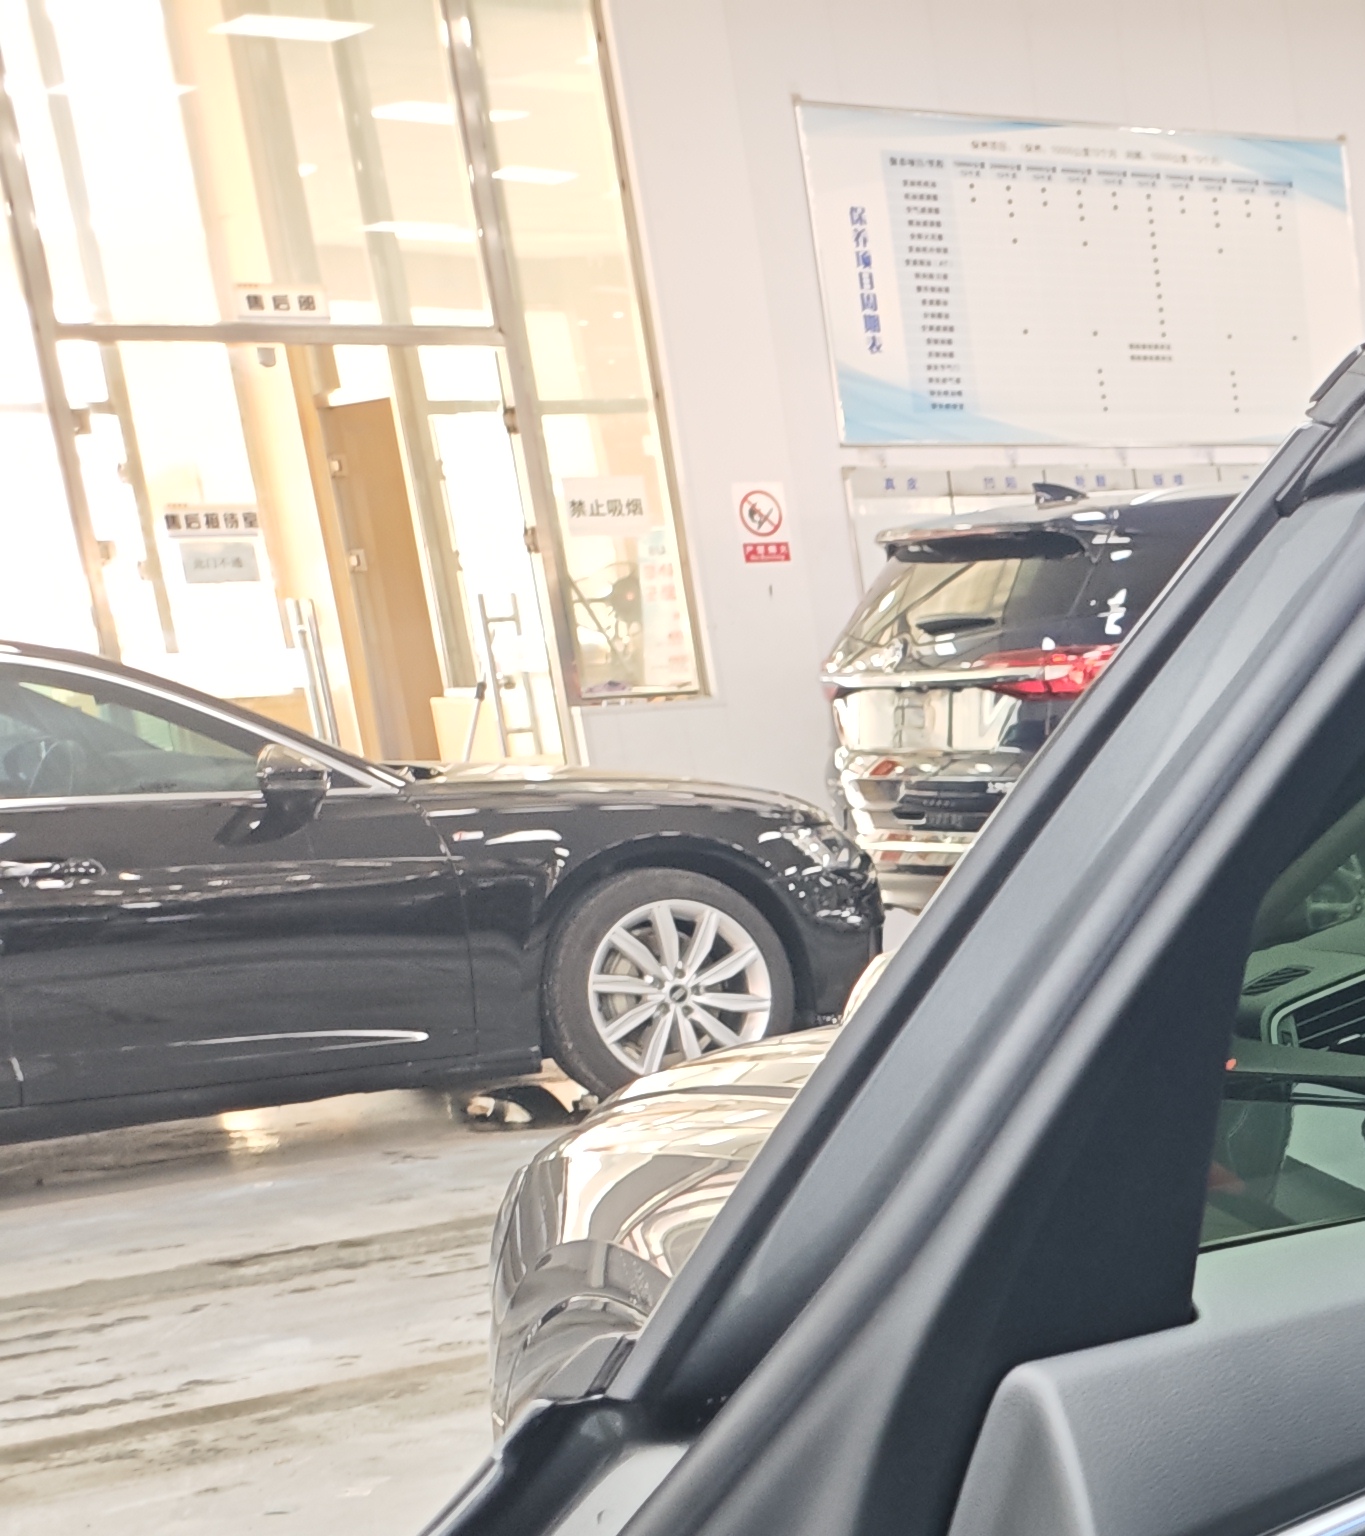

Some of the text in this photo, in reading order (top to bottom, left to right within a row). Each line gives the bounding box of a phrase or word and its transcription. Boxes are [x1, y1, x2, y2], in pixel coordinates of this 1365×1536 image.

[246, 293, 317, 312] 售后部
[568, 498, 645, 518] 禁止吸烟
[164, 511, 260, 530] 售后接待室
